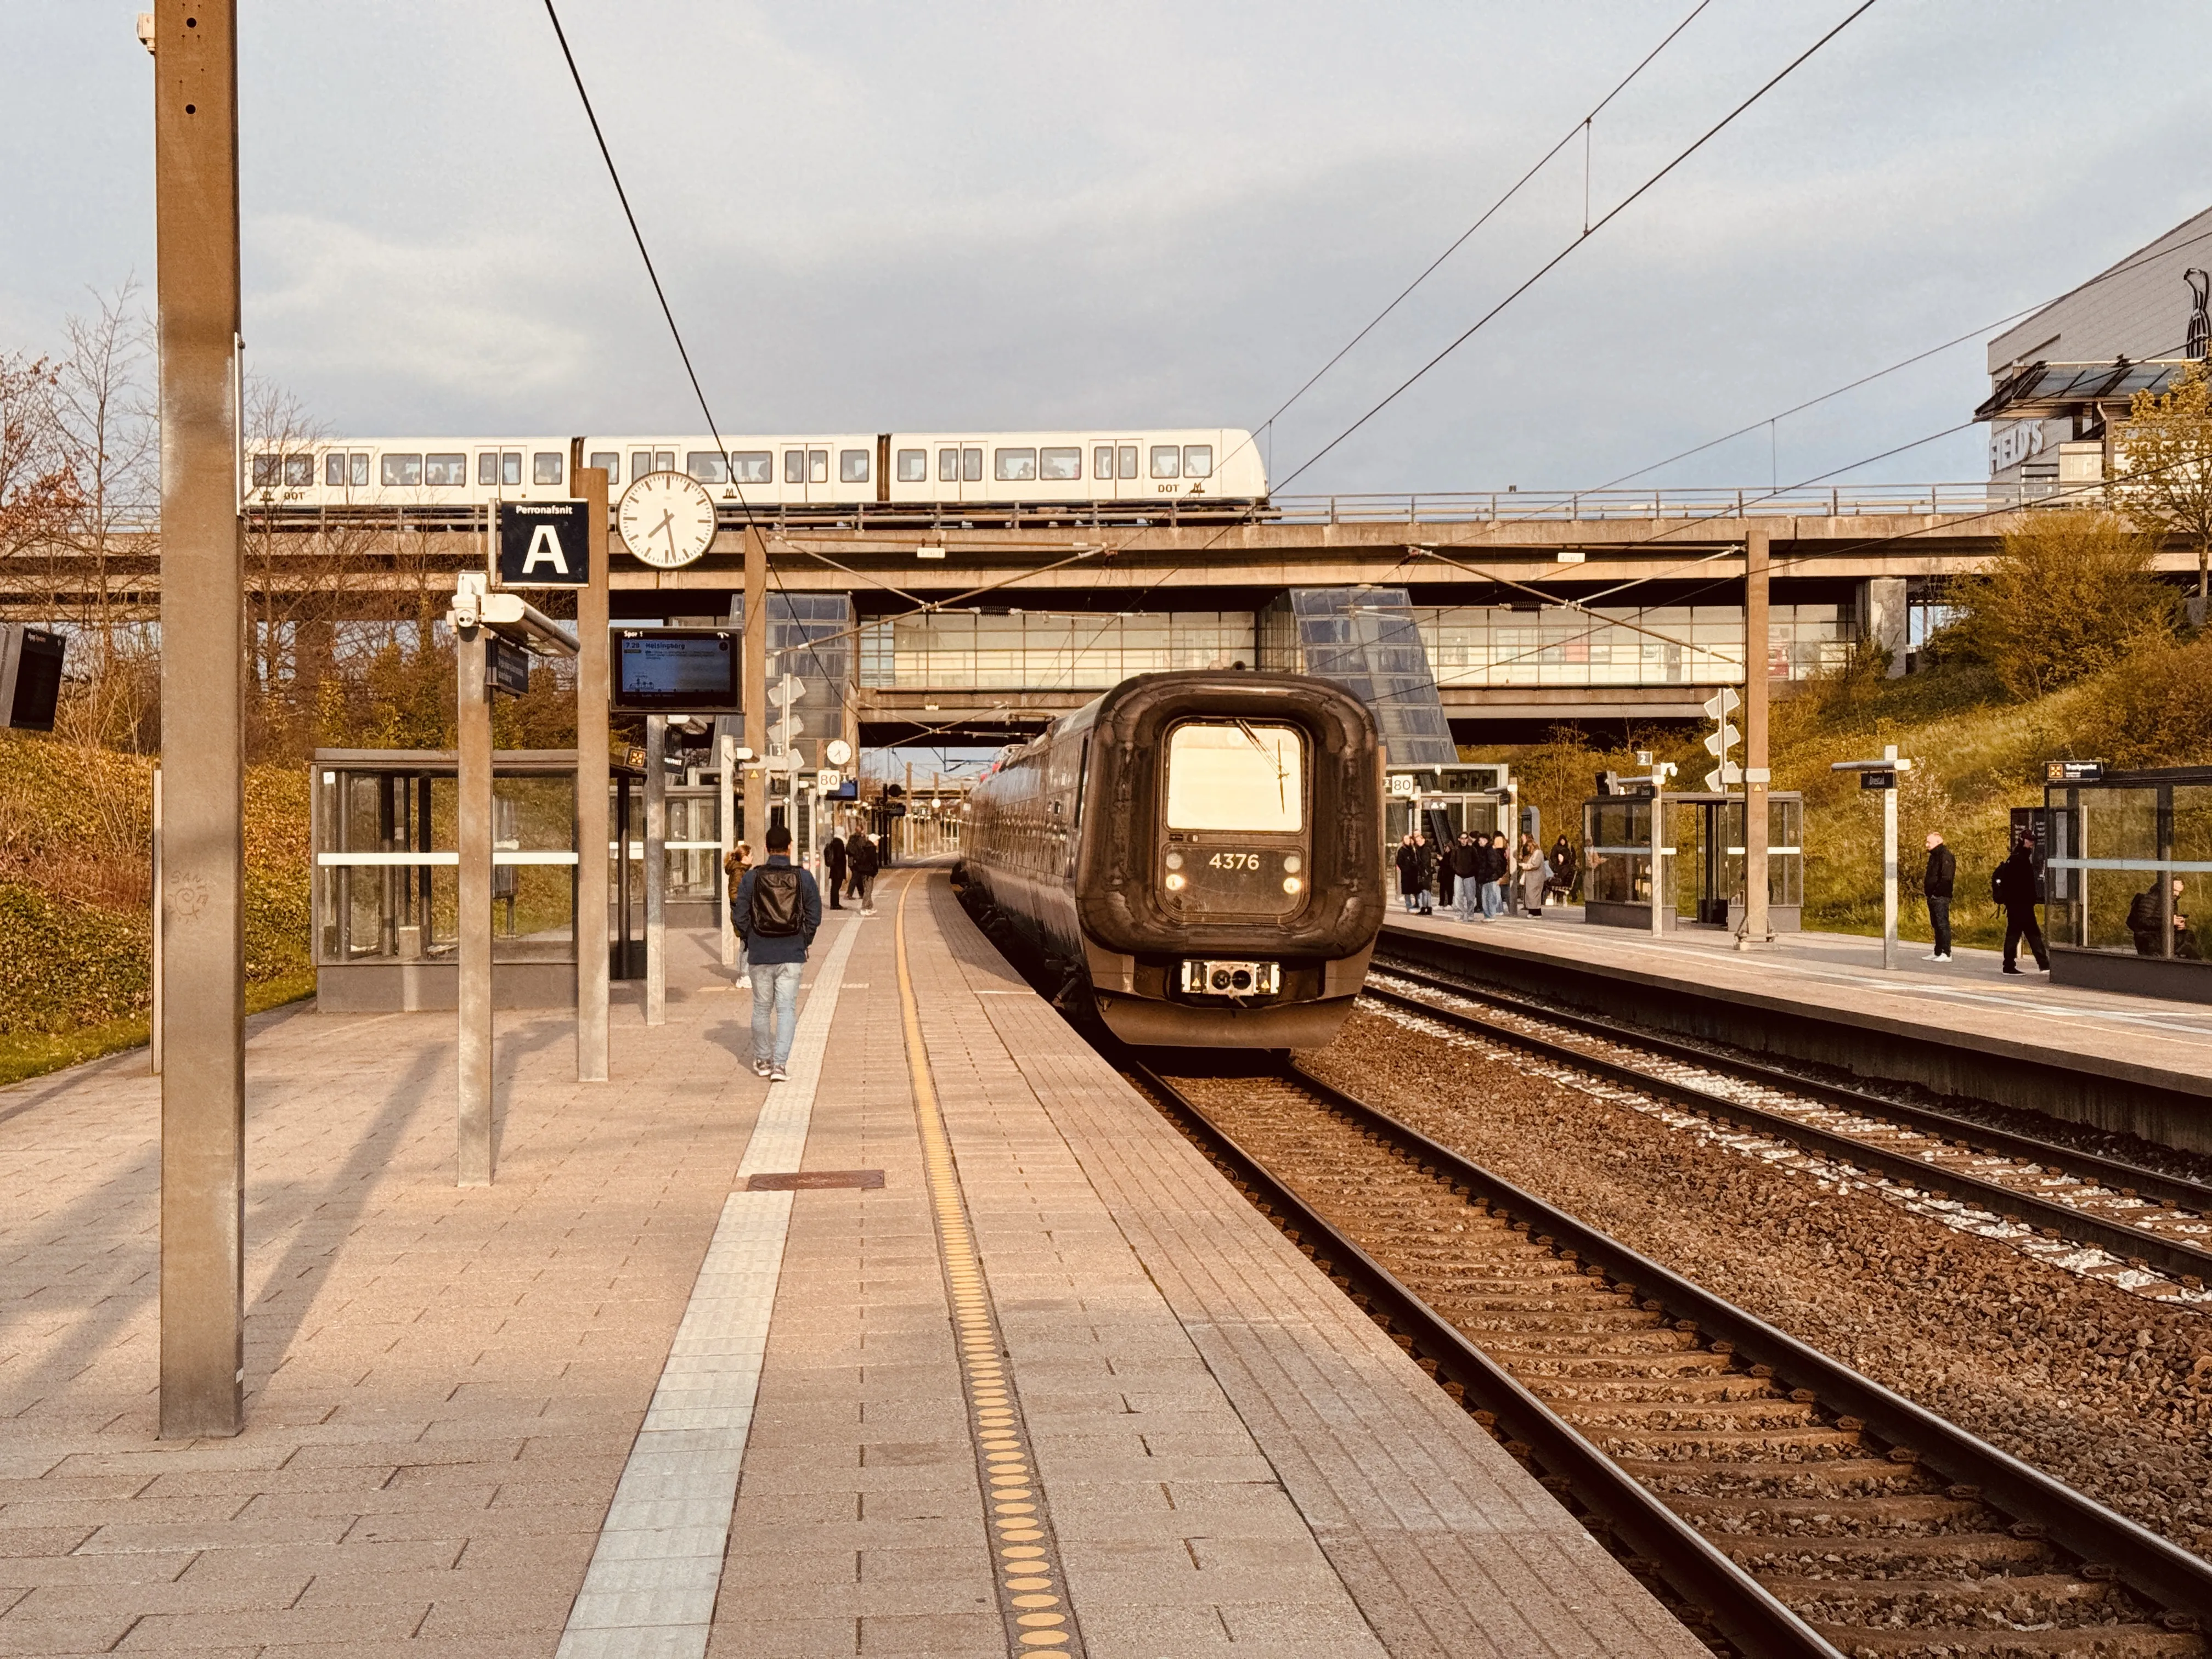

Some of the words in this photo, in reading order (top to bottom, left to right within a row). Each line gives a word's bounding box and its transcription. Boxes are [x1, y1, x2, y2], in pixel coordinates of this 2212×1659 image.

[1158, 484, 1180, 493] DOT
[516, 505, 574, 515] Perronafsnit
[522, 524, 569, 574] A
[624, 630, 637, 638] Spor
[1639, 755, 1646, 763] 2
[820, 774, 838, 786] 80
[1393, 779, 1411, 791] 80
[1209, 853, 1260, 870] 4376
